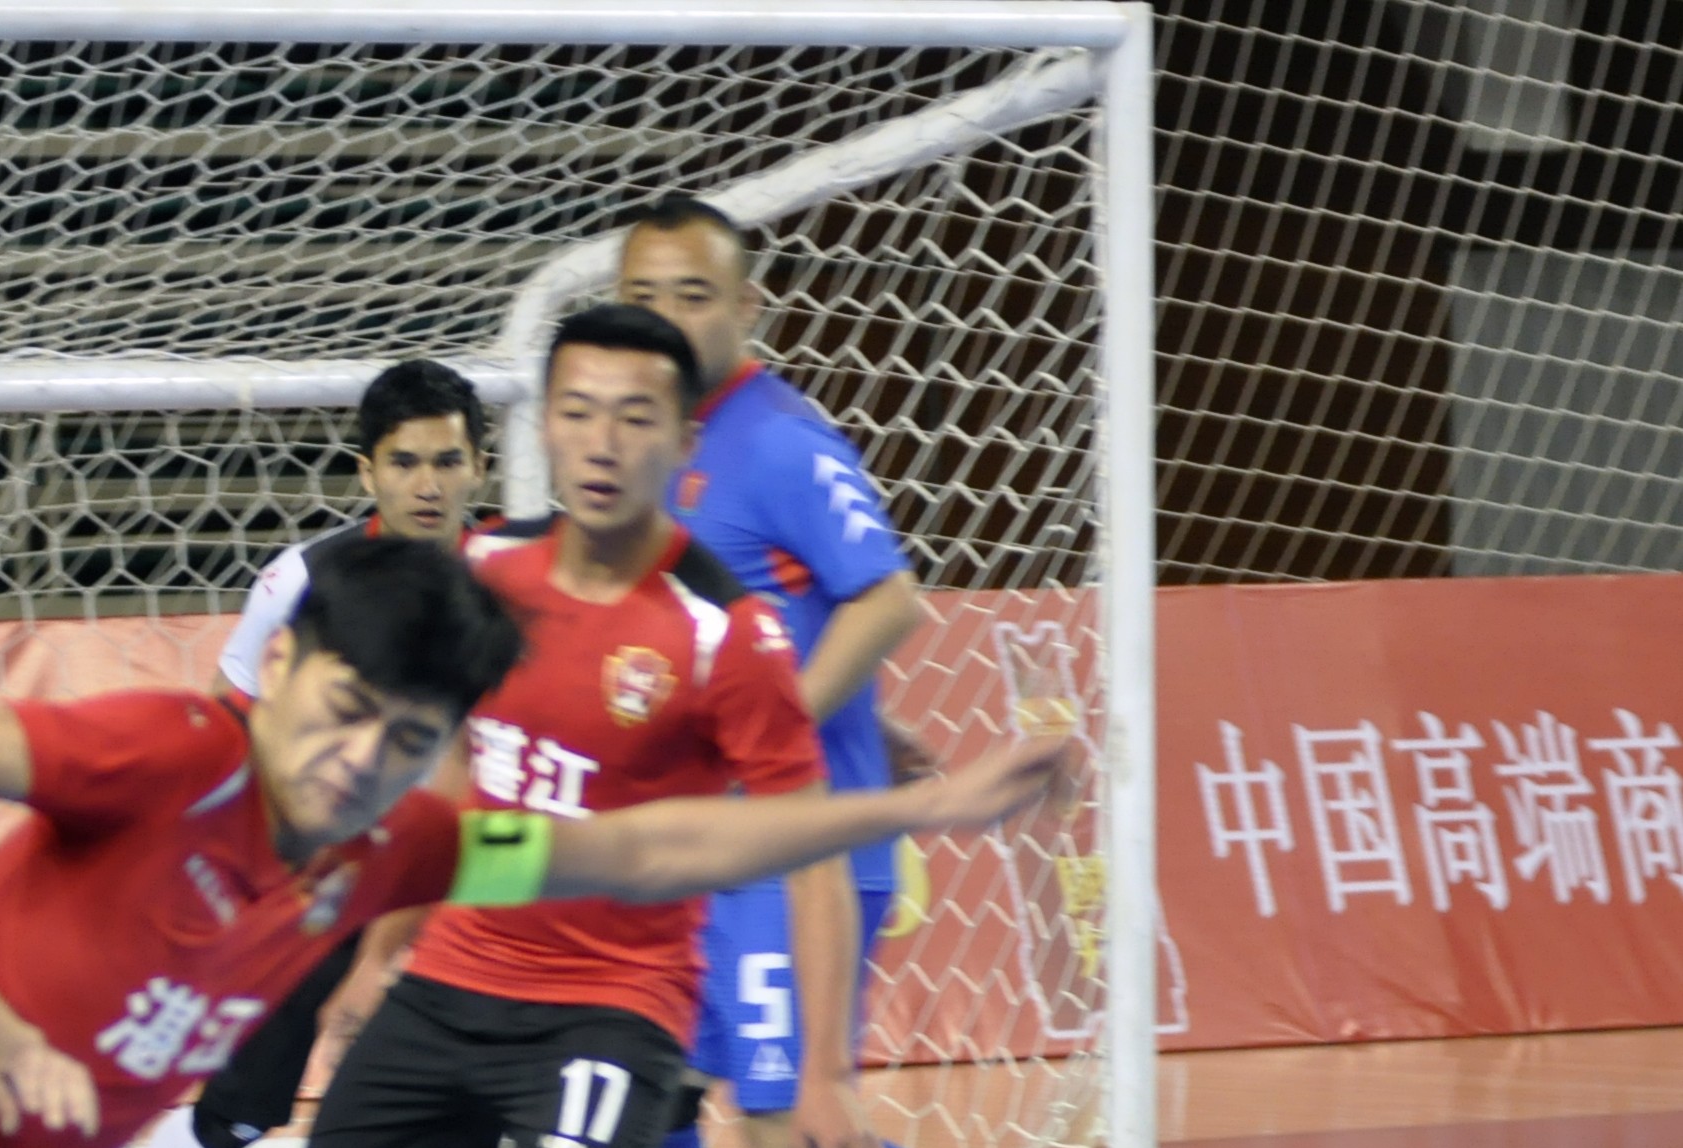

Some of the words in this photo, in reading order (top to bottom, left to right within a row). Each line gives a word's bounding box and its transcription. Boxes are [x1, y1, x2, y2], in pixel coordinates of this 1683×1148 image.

[1196, 708, 1683, 918] 中国高端商
[735, 951, 793, 1039] 5
[558, 1057, 632, 1144] 17
